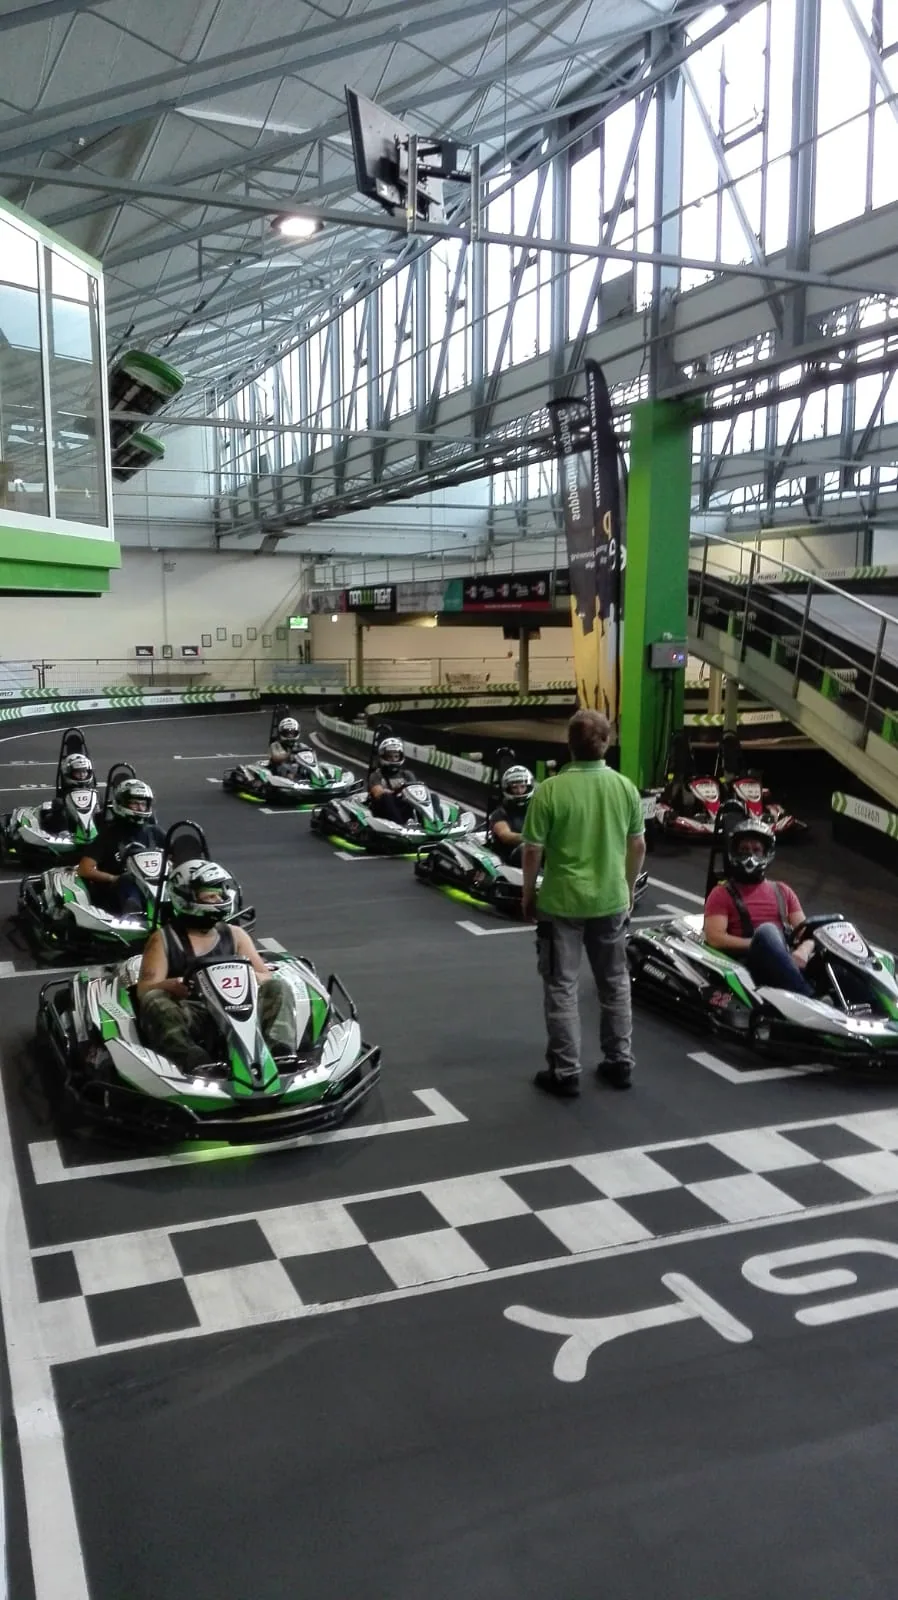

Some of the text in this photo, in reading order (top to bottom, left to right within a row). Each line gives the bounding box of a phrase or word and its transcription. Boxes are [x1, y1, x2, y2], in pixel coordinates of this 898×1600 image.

[77, 795, 88, 803] 16
[143, 860, 158, 868] 15
[839, 932, 858, 944] 22
[222, 977, 243, 989] 21
